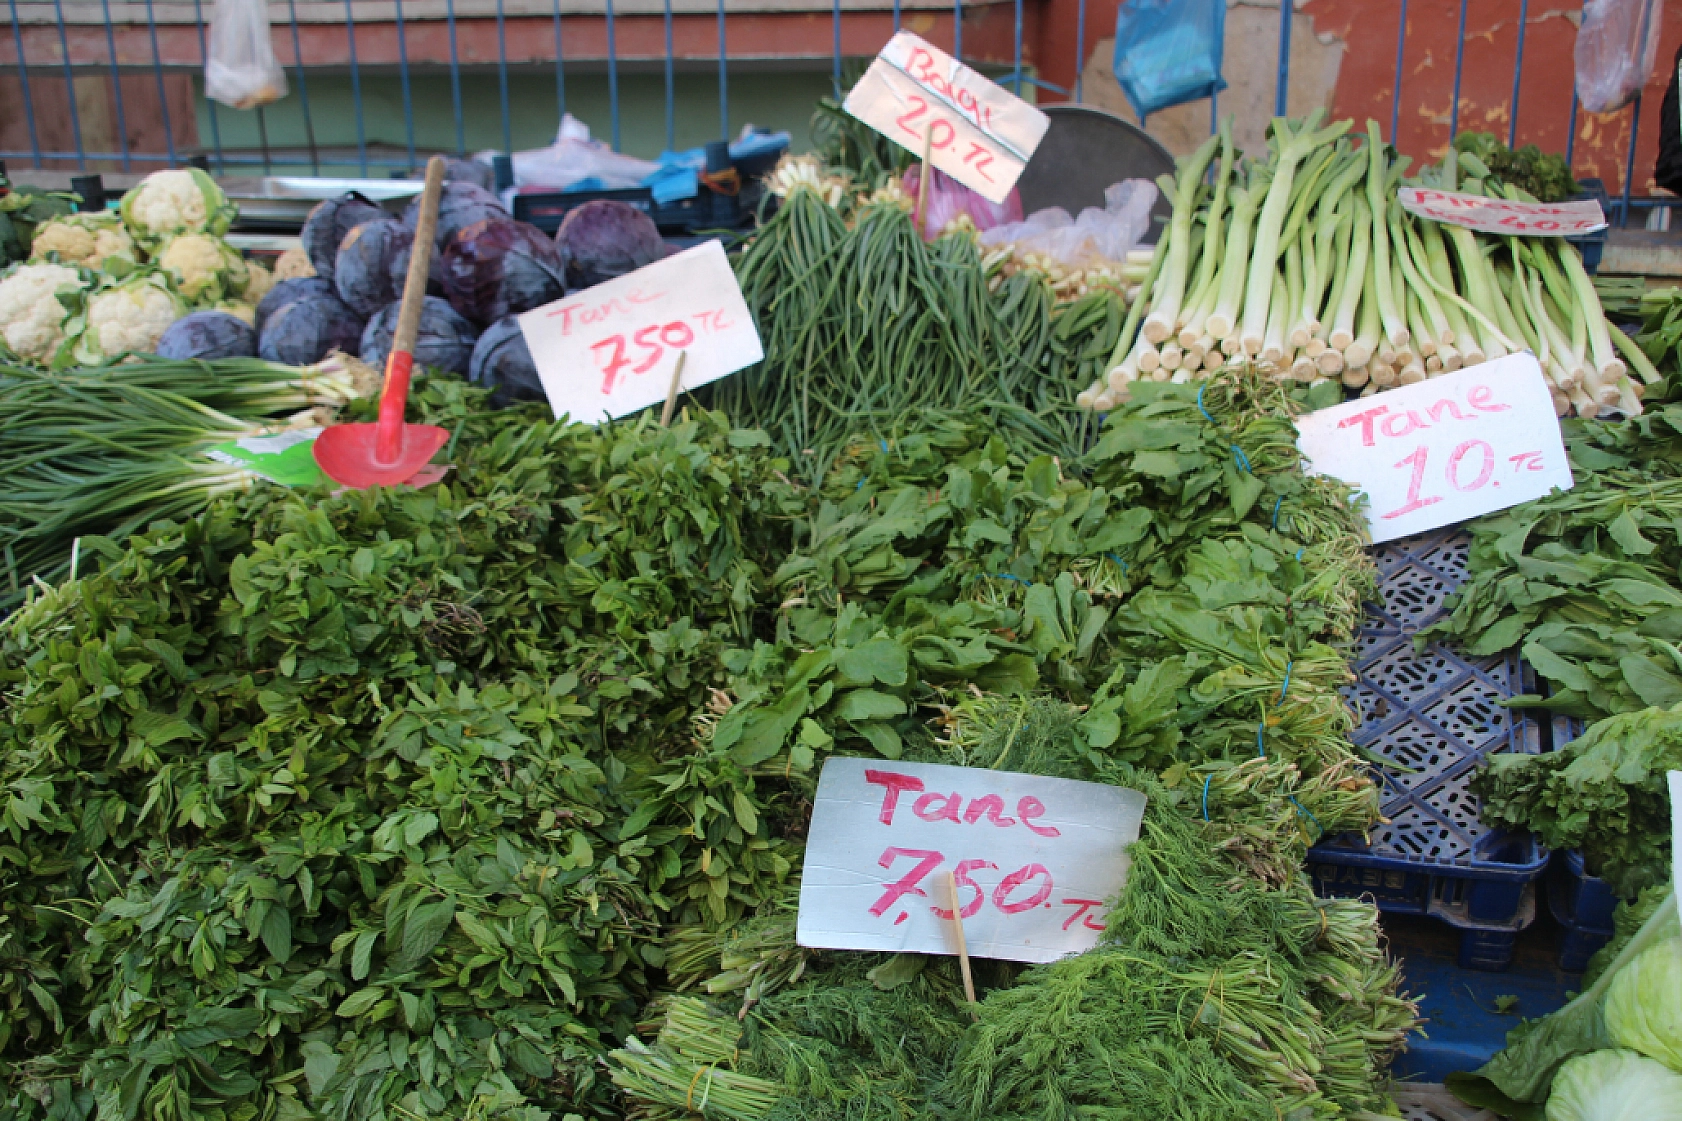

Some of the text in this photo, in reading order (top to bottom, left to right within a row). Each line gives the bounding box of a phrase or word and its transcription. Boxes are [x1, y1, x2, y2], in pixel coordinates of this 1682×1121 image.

[546, 288, 668, 335] Tane
[1337, 385, 1512, 446] Tane
[864, 769, 1061, 837] Tane
